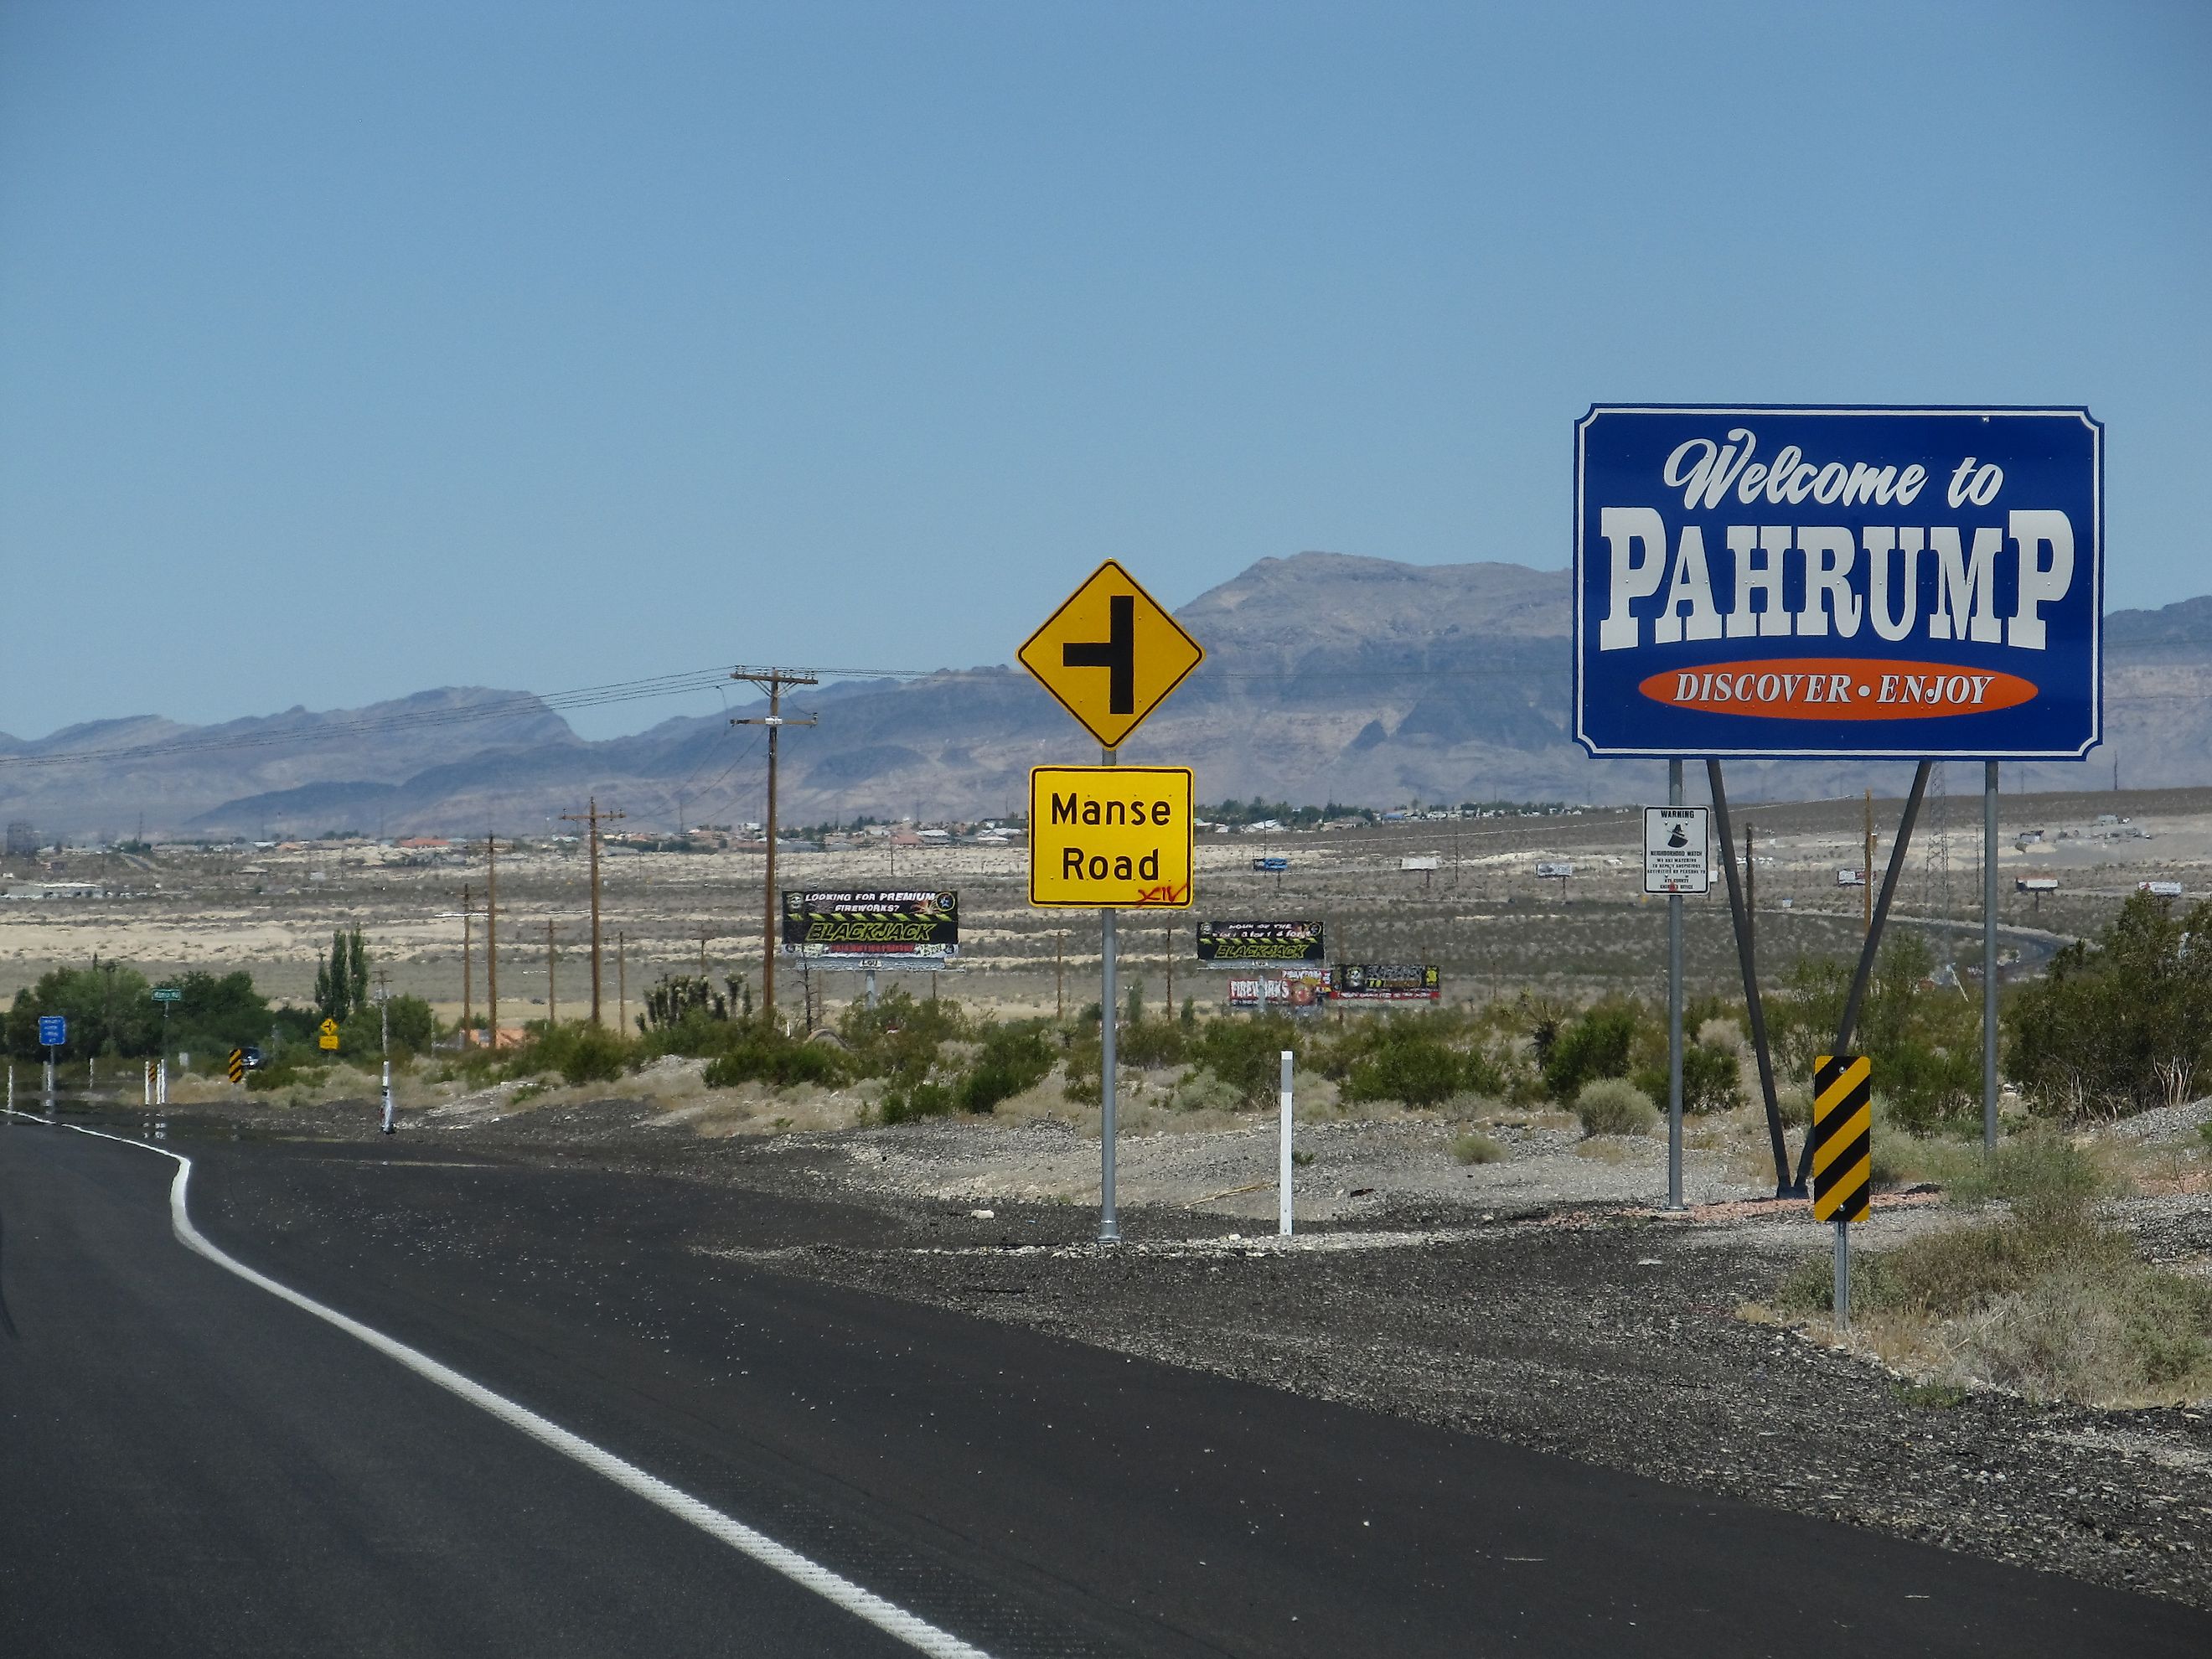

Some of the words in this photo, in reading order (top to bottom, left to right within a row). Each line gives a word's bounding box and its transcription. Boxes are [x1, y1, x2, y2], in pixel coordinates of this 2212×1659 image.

[1663, 427, 1930, 510] Welcome
[1948, 457, 2004, 509] to
[1600, 506, 2075, 653] PAHRUMP
[1672, 673, 1853, 705] DISCOVER
[1876, 674, 1994, 706] ENJOY
[1052, 792, 1171, 826] Manse
[1661, 810, 1695, 819] WARNING
[1062, 847, 1159, 881] Road
[805, 892, 852, 902] LOOKING
[855, 892, 876, 902] FOR
[879, 891, 936, 902] PREMIUM
[1136, 883, 1187, 907] XIV
[835, 902, 901, 913] FIREWORKS?
[804, 920, 938, 942] BLACKJACK
[1213, 943, 1310, 960] BLACKJACK
